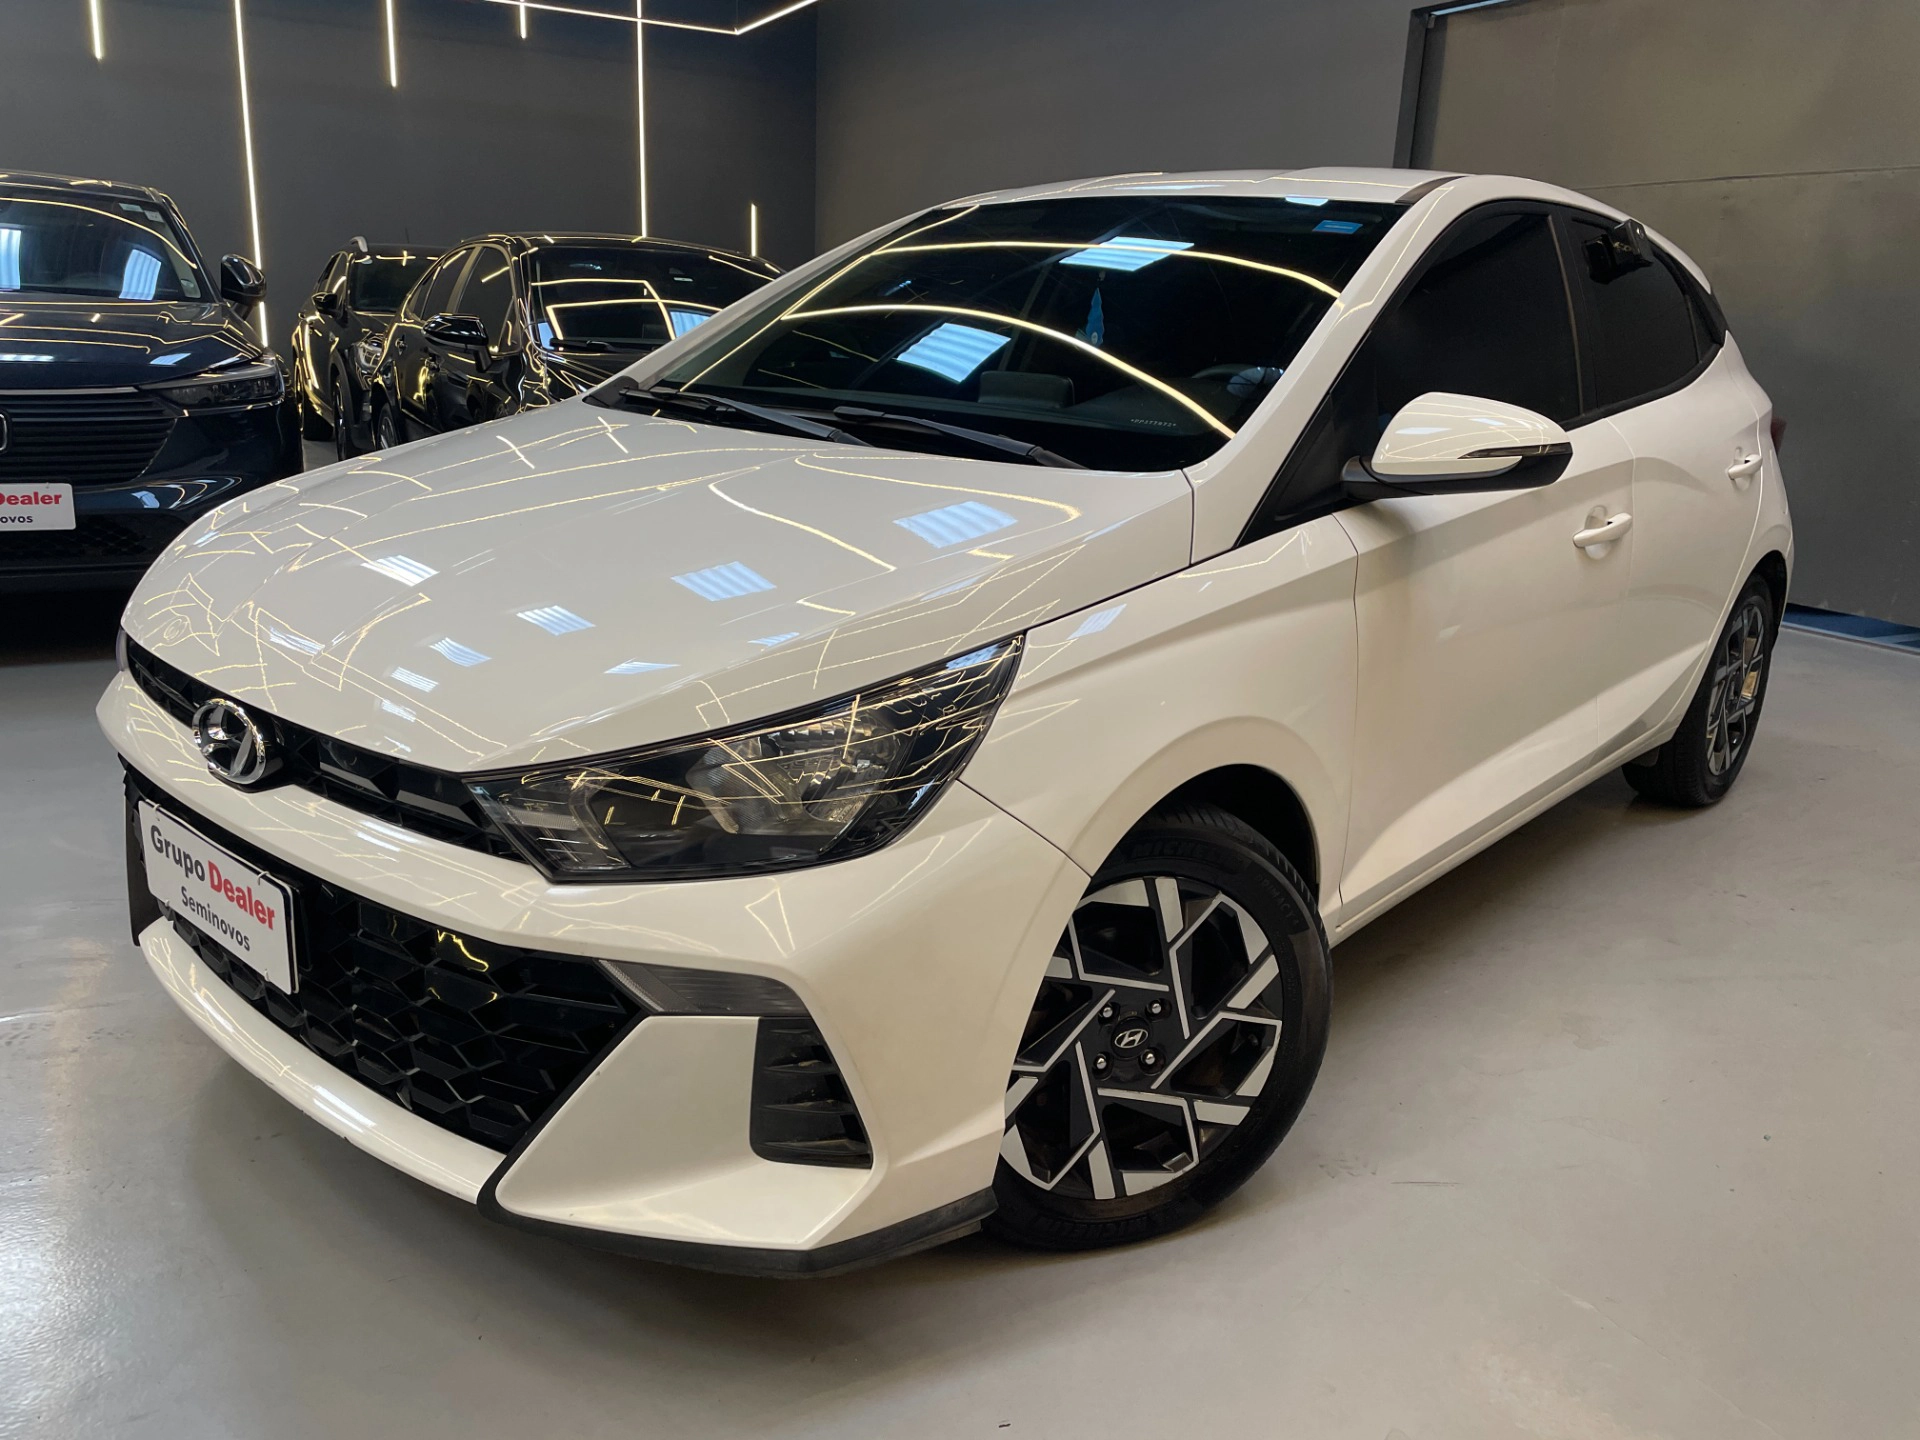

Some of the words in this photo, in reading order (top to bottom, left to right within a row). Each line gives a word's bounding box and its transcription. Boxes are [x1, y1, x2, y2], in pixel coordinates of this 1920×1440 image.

[151, 824, 206, 882] Grupo
[207, 860, 275, 930] Dealer
[1132, 840, 1240, 868] MICHEL
[181, 885, 250, 951] Seminovos
